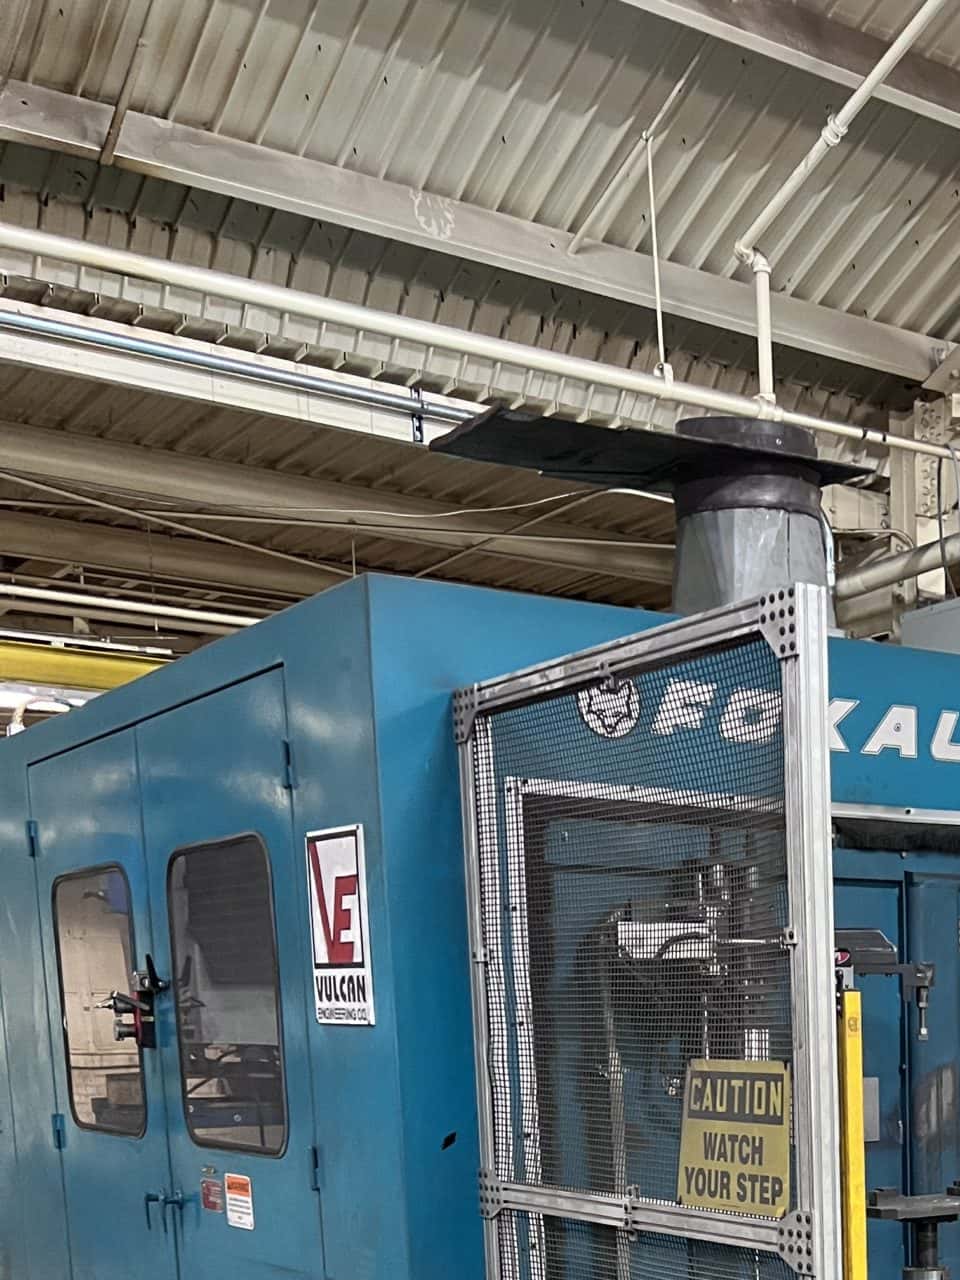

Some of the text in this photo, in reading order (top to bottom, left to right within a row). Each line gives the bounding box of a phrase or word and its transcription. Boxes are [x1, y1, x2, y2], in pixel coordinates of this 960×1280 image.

[315, 974, 367, 1003] VULCAN
[690, 1077, 783, 1117] CAUTION
[703, 1131, 764, 1167] WATCH
[684, 1166, 784, 1207] YOUR STEP
